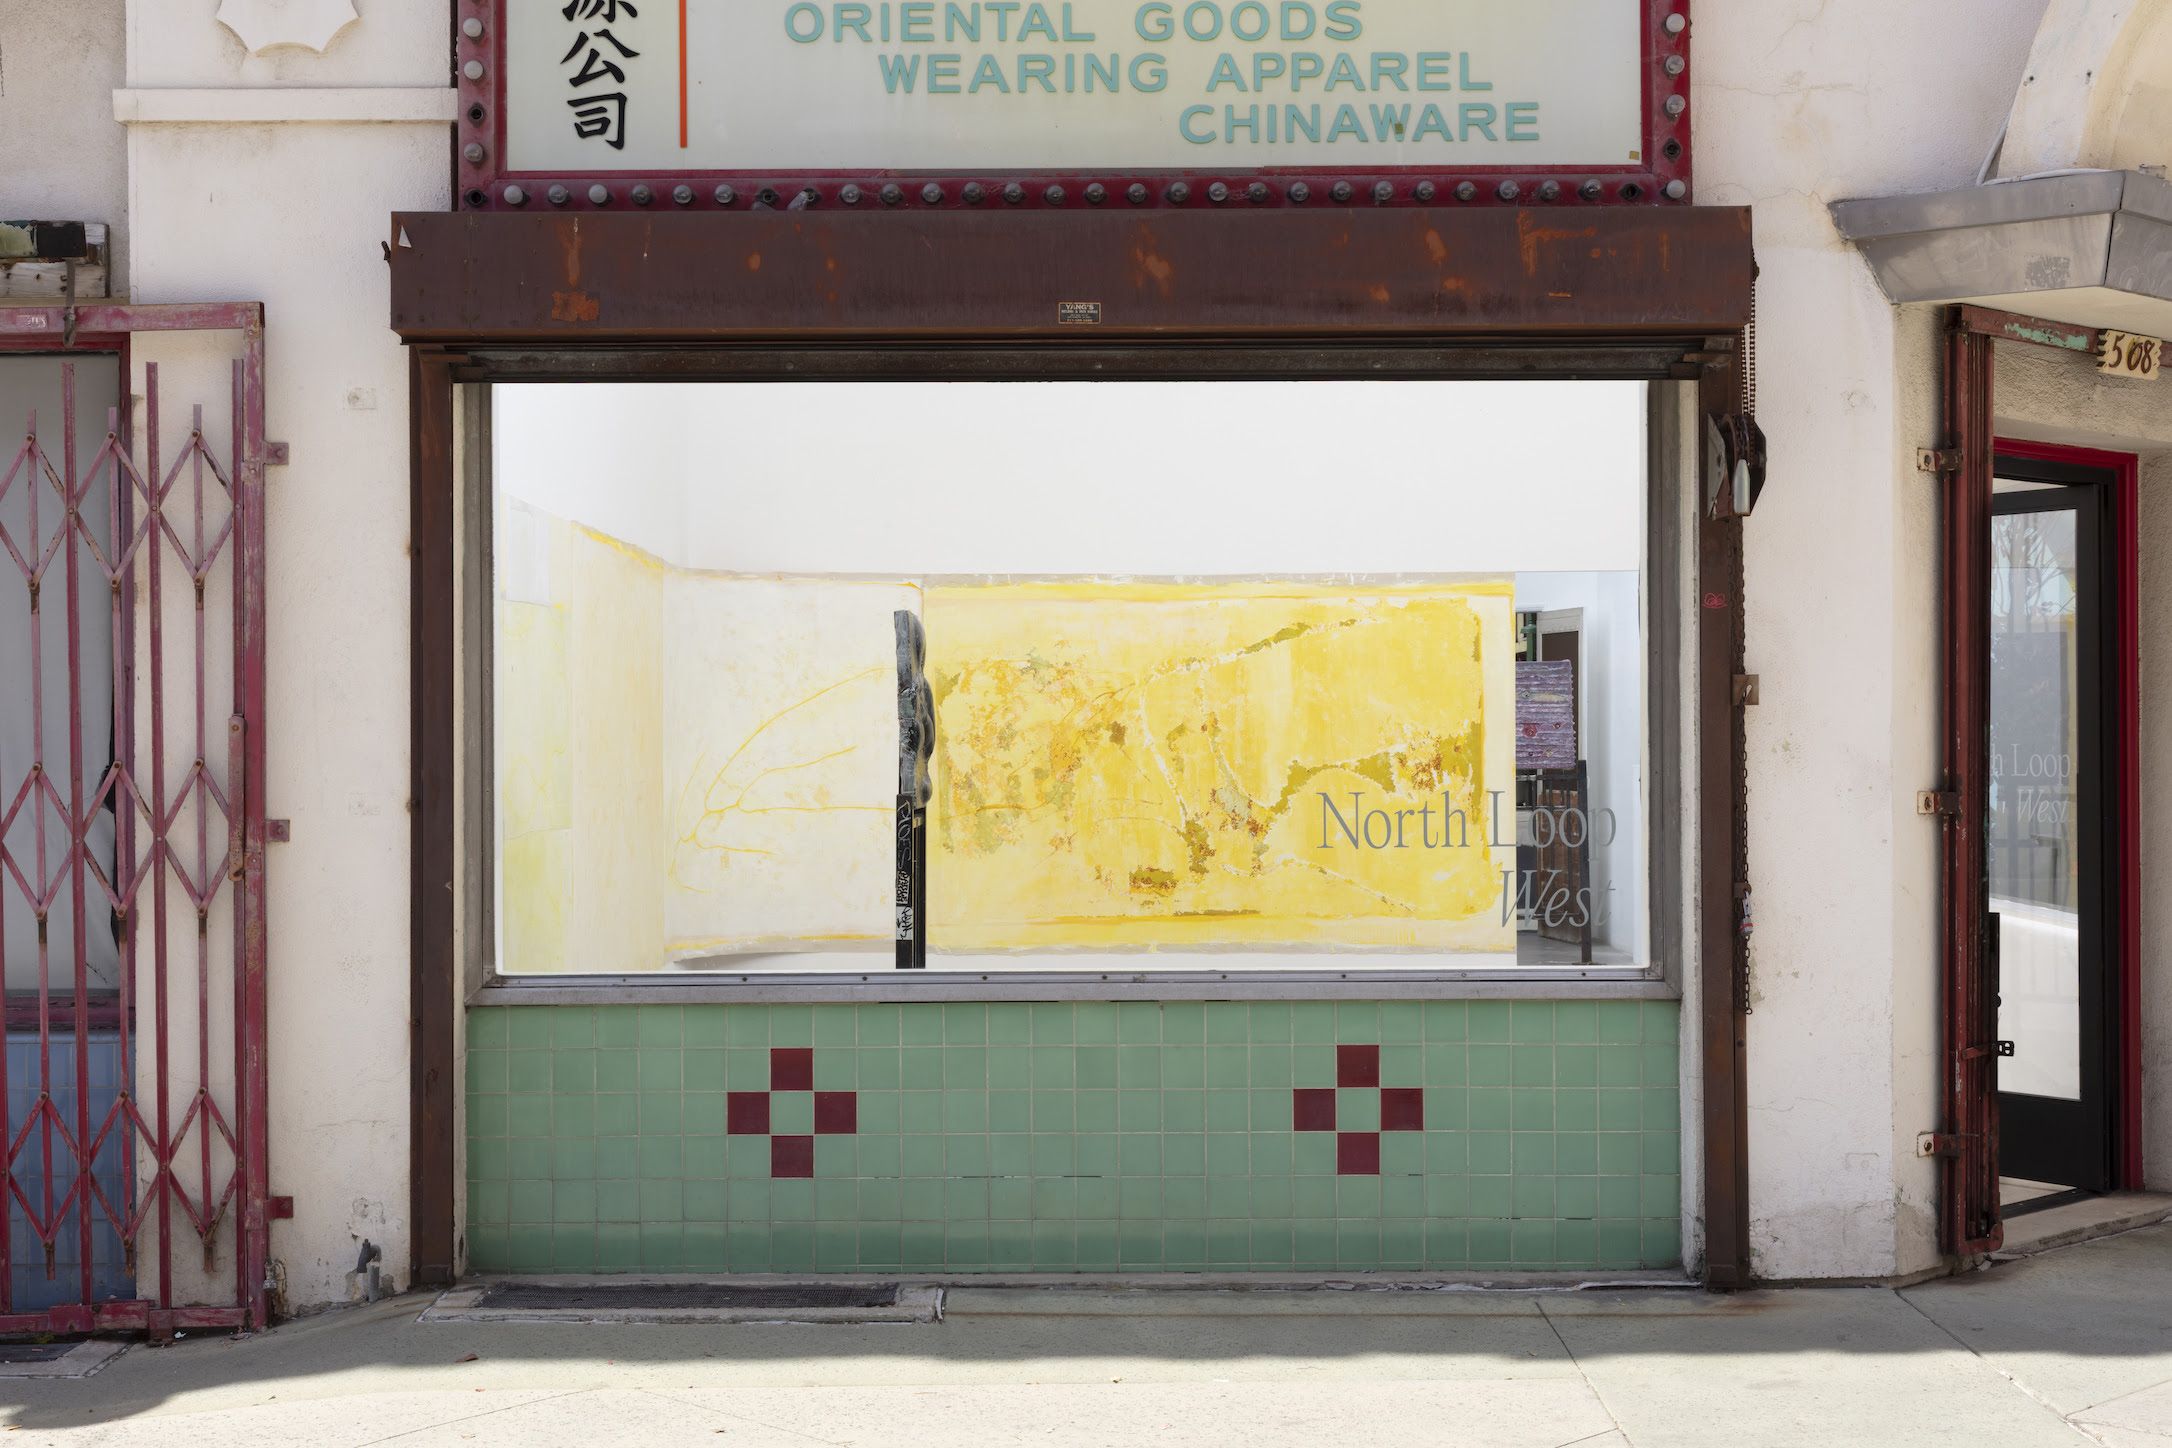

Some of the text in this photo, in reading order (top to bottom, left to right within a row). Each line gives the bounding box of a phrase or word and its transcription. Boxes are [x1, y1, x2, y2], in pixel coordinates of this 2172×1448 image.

[784, 1, 1363, 43] ORIENTAL GOODS
[878, 51, 1493, 94] WEARING APPAREL
[1179, 102, 1540, 144] CHINAWARE
[2107, 333, 2156, 375] 508
[2010, 743, 2071, 787] Loop
[1316, 790, 1617, 862] North Loop
[2017, 788, 2070, 823] West
[1500, 869, 1617, 928] West
